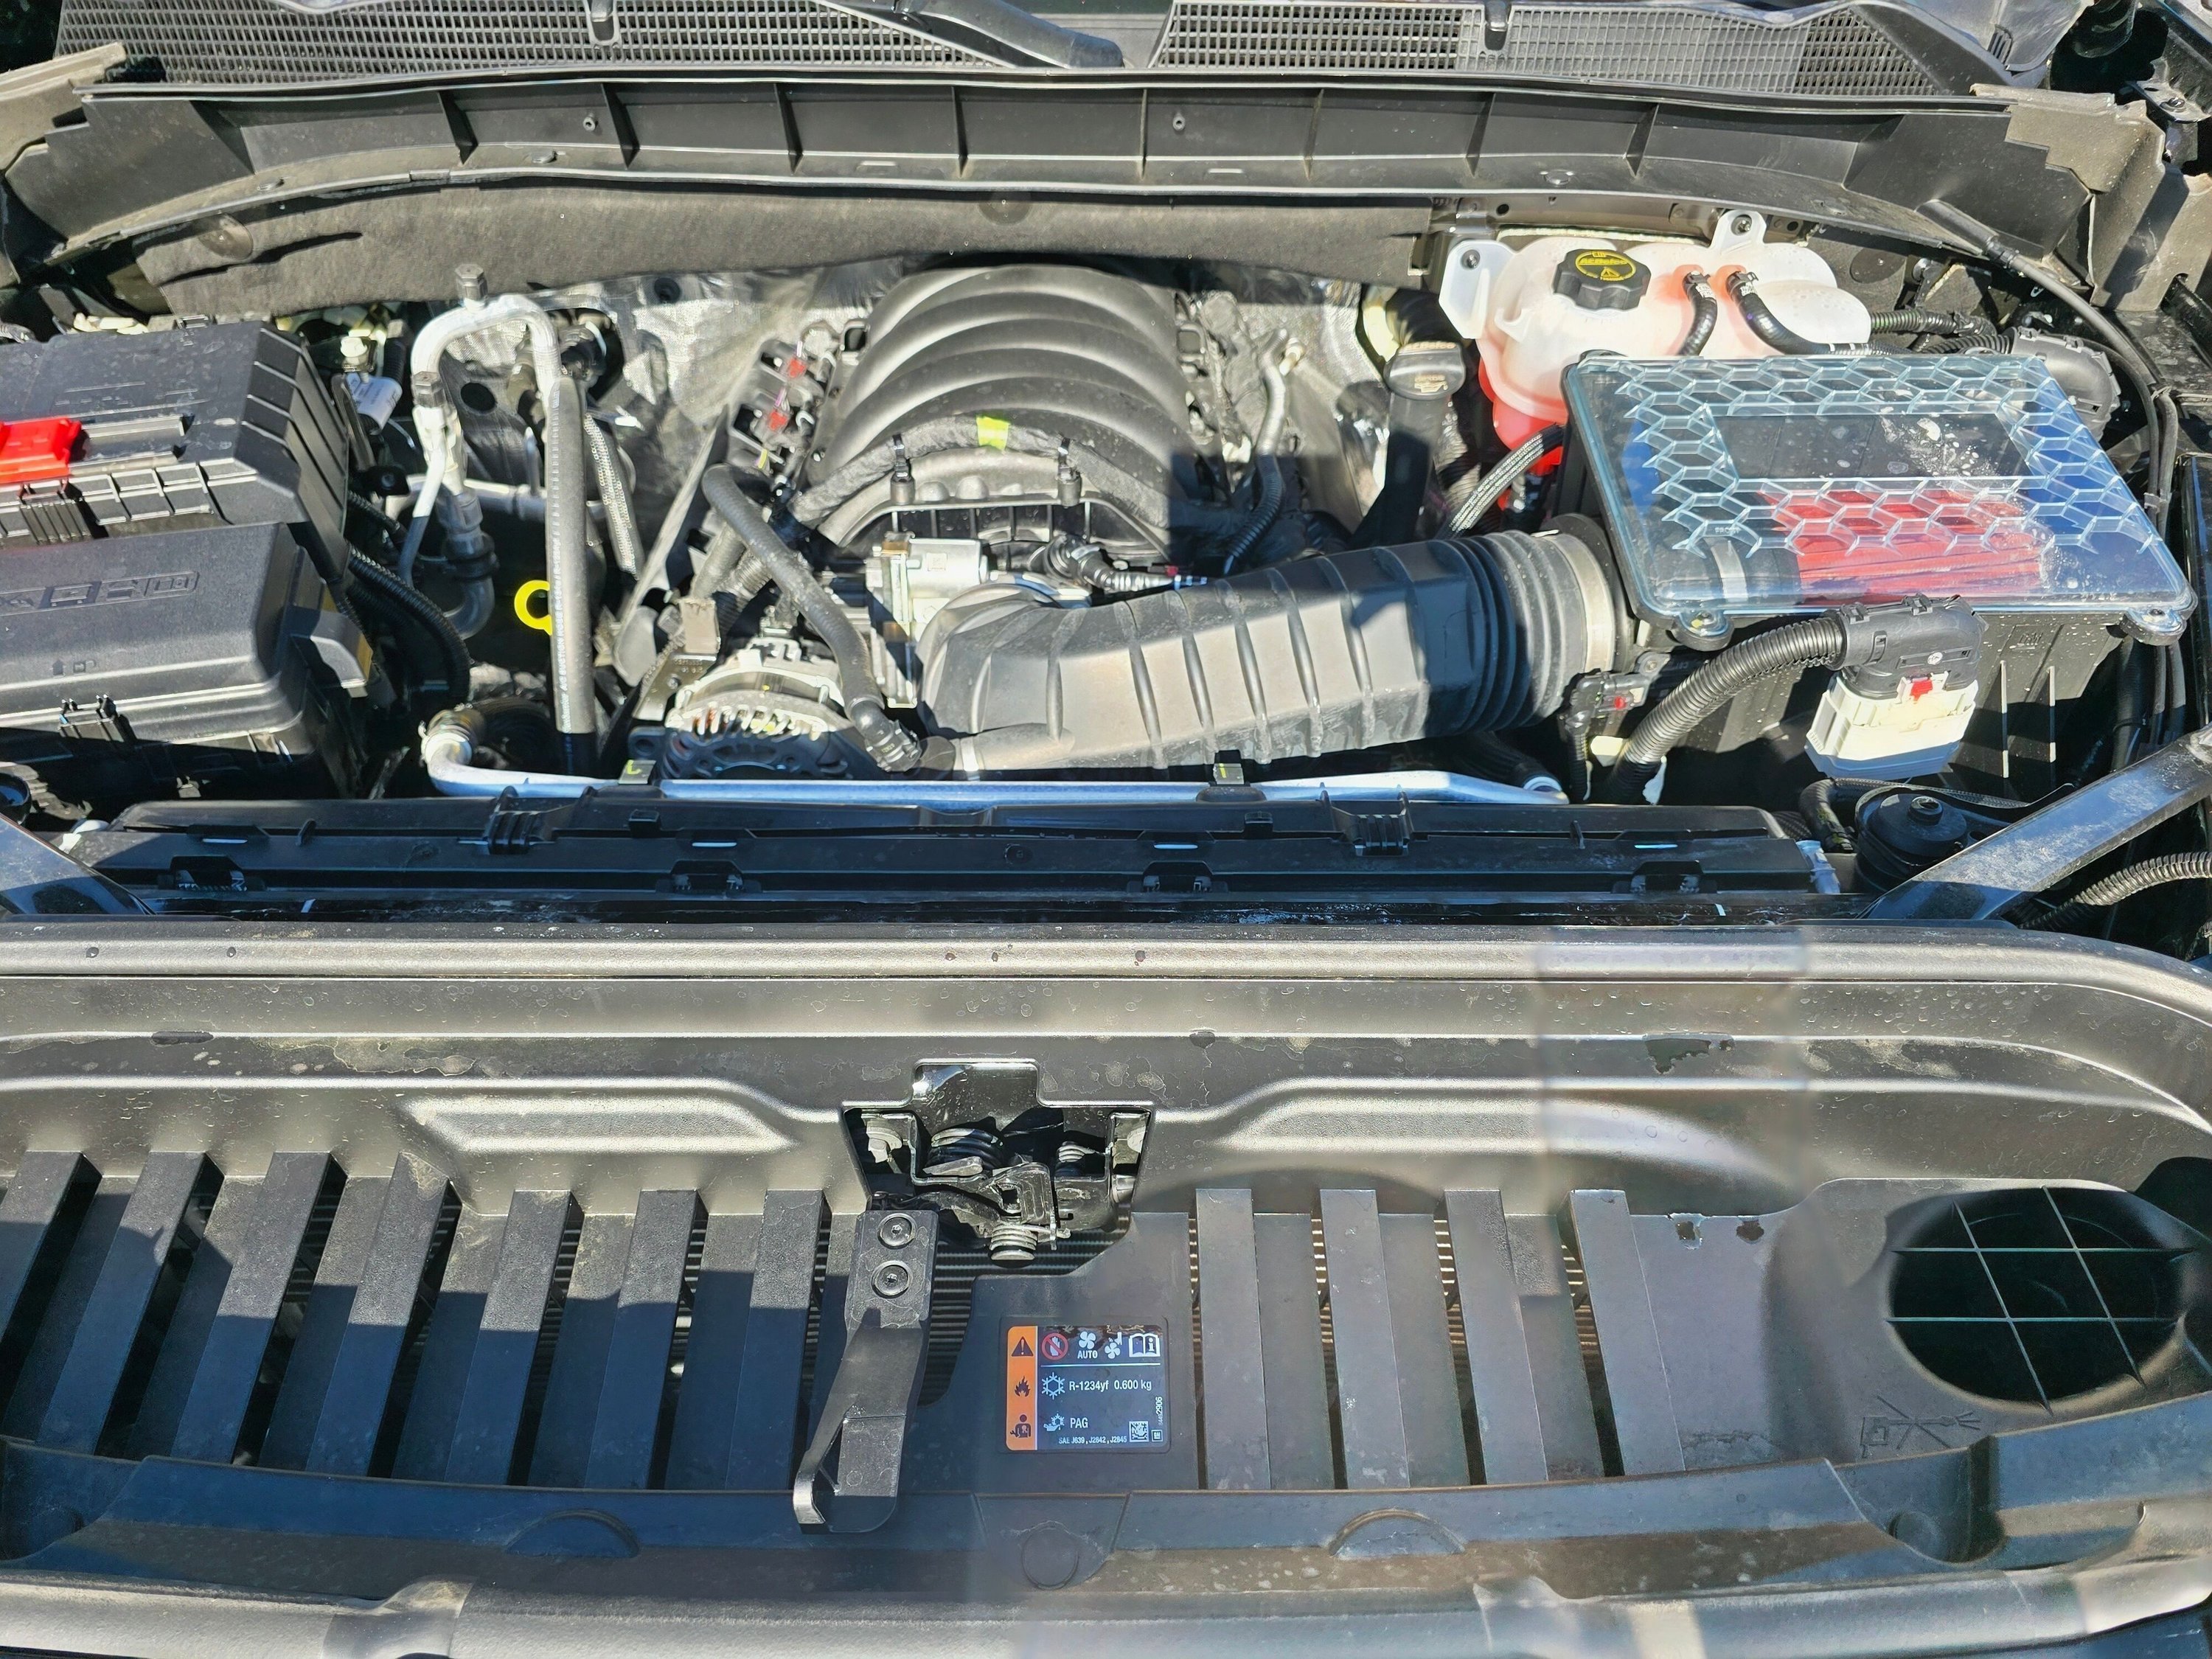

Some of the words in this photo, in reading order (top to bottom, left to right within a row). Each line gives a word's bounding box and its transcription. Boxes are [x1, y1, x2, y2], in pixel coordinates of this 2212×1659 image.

[1077, 1349, 1098, 1359] AUTO
[1069, 1380, 1109, 1392] R-1234yf
[1114, 1380, 1138, 1390] 0.600
[1141, 1380, 1152, 1391] kg
[1070, 1417, 1088, 1428] PAG
[1059, 1436, 1070, 1444] SAE
[1110, 1435, 1127, 1444] J2845
